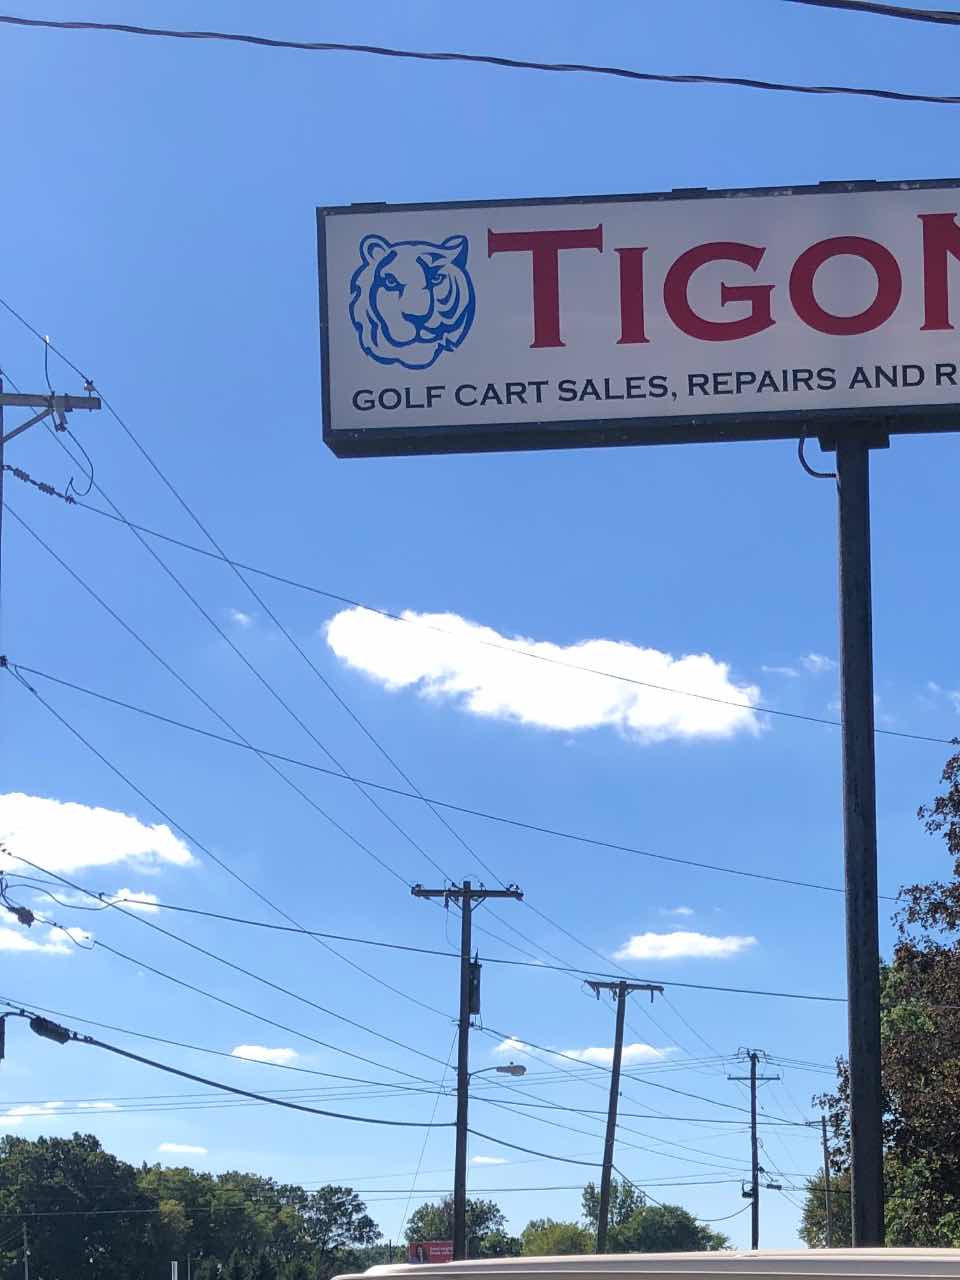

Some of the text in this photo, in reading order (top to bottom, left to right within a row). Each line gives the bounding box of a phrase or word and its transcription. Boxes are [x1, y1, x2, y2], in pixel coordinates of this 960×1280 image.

[352, 385, 446, 411] GOLF
[454, 380, 549, 406] CART
[558, 375, 677, 402] SALES,
[687, 367, 837, 396] REPAIRS
[848, 364, 926, 389] AND
